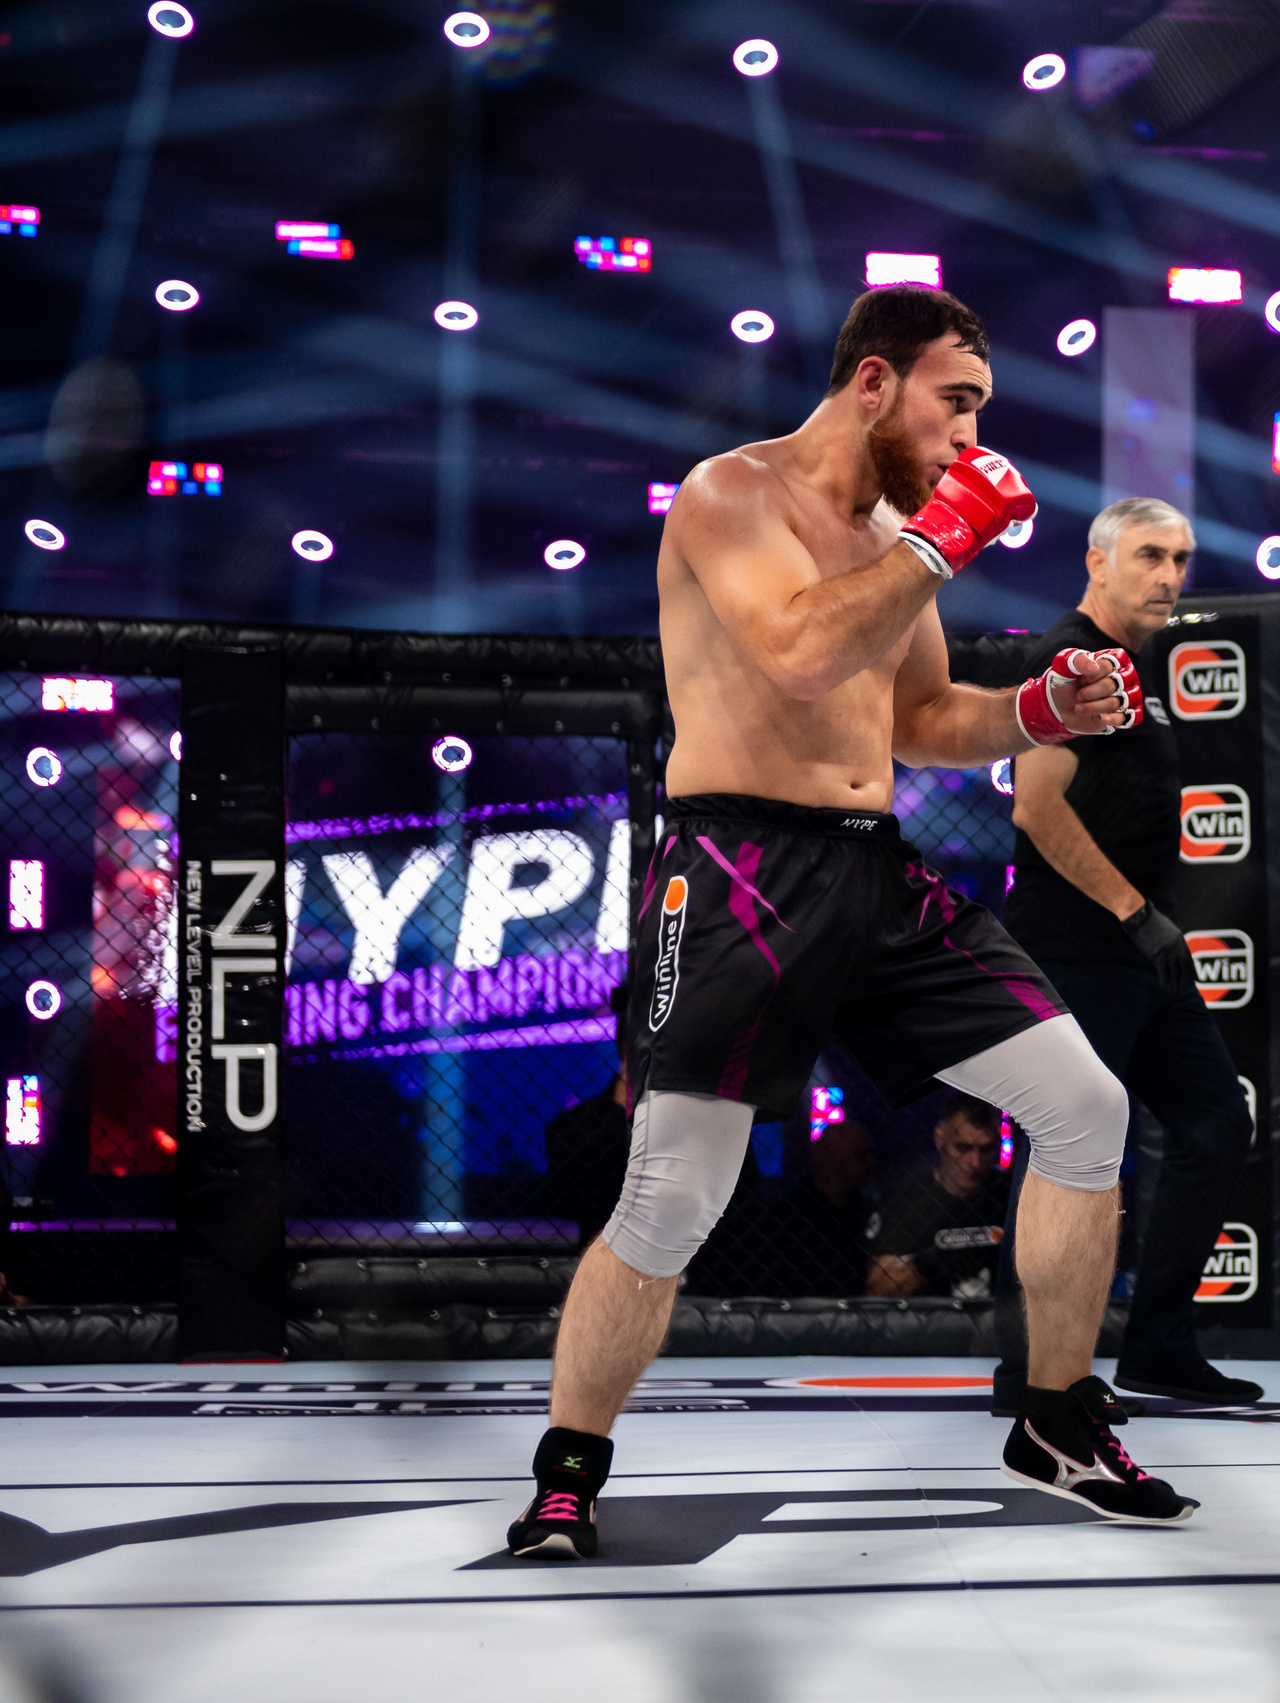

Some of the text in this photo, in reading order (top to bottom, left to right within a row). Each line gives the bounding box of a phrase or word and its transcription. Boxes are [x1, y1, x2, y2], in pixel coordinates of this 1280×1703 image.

[1186, 668, 1239, 692] Win
[840, 818, 878, 831] HYPE
[1190, 812, 1243, 836] Win
[654, 920, 677, 1019] Winline
[1197, 956, 1247, 981] Win
[186, 860, 203, 1133] NEW LEVEL PRODUCTION
[211, 859, 278, 1132] NLP
